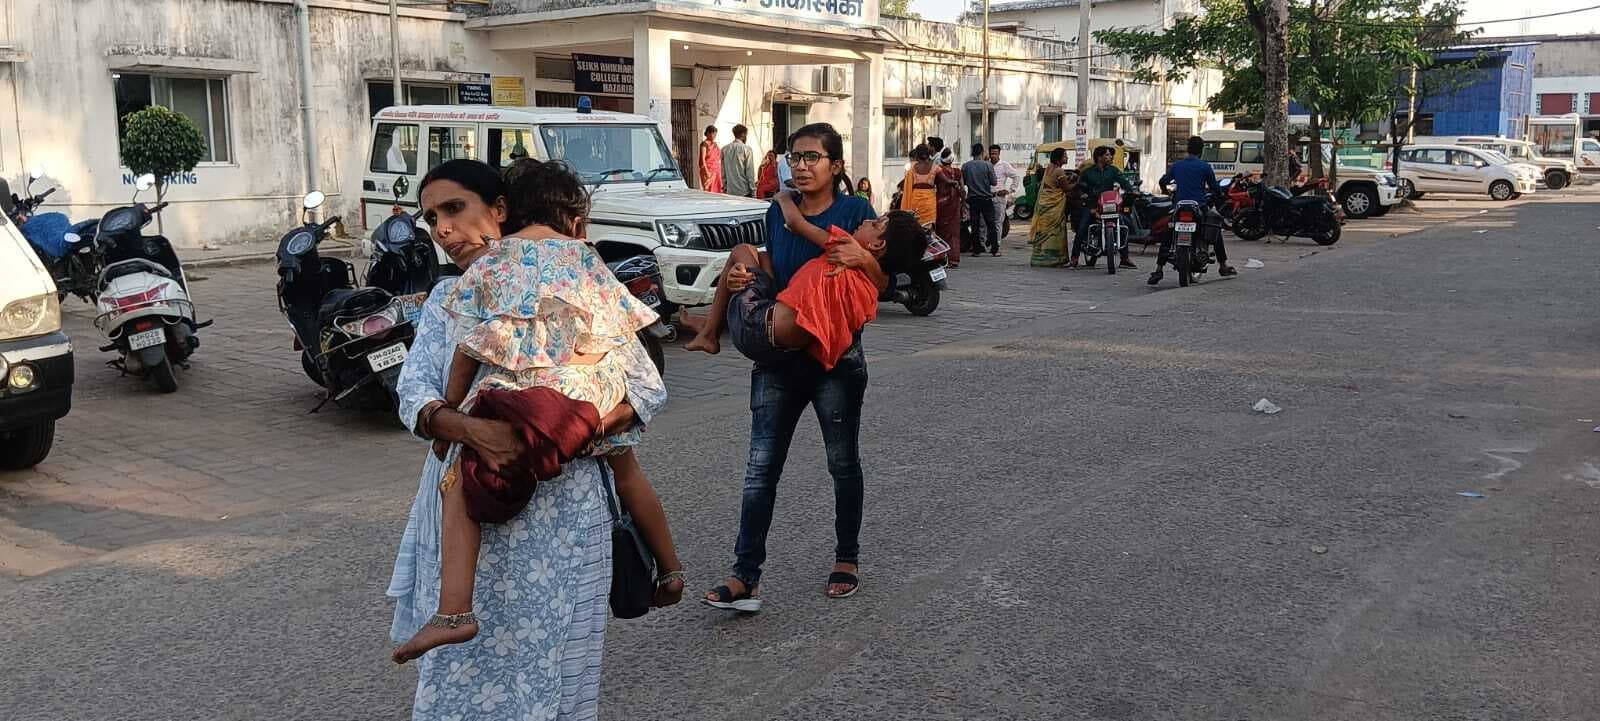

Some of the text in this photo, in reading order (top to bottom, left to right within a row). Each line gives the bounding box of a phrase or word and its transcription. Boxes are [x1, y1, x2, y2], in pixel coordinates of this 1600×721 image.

[577, 61, 600, 71] SEIKH
[590, 72, 634, 84] COLLEGE HO
